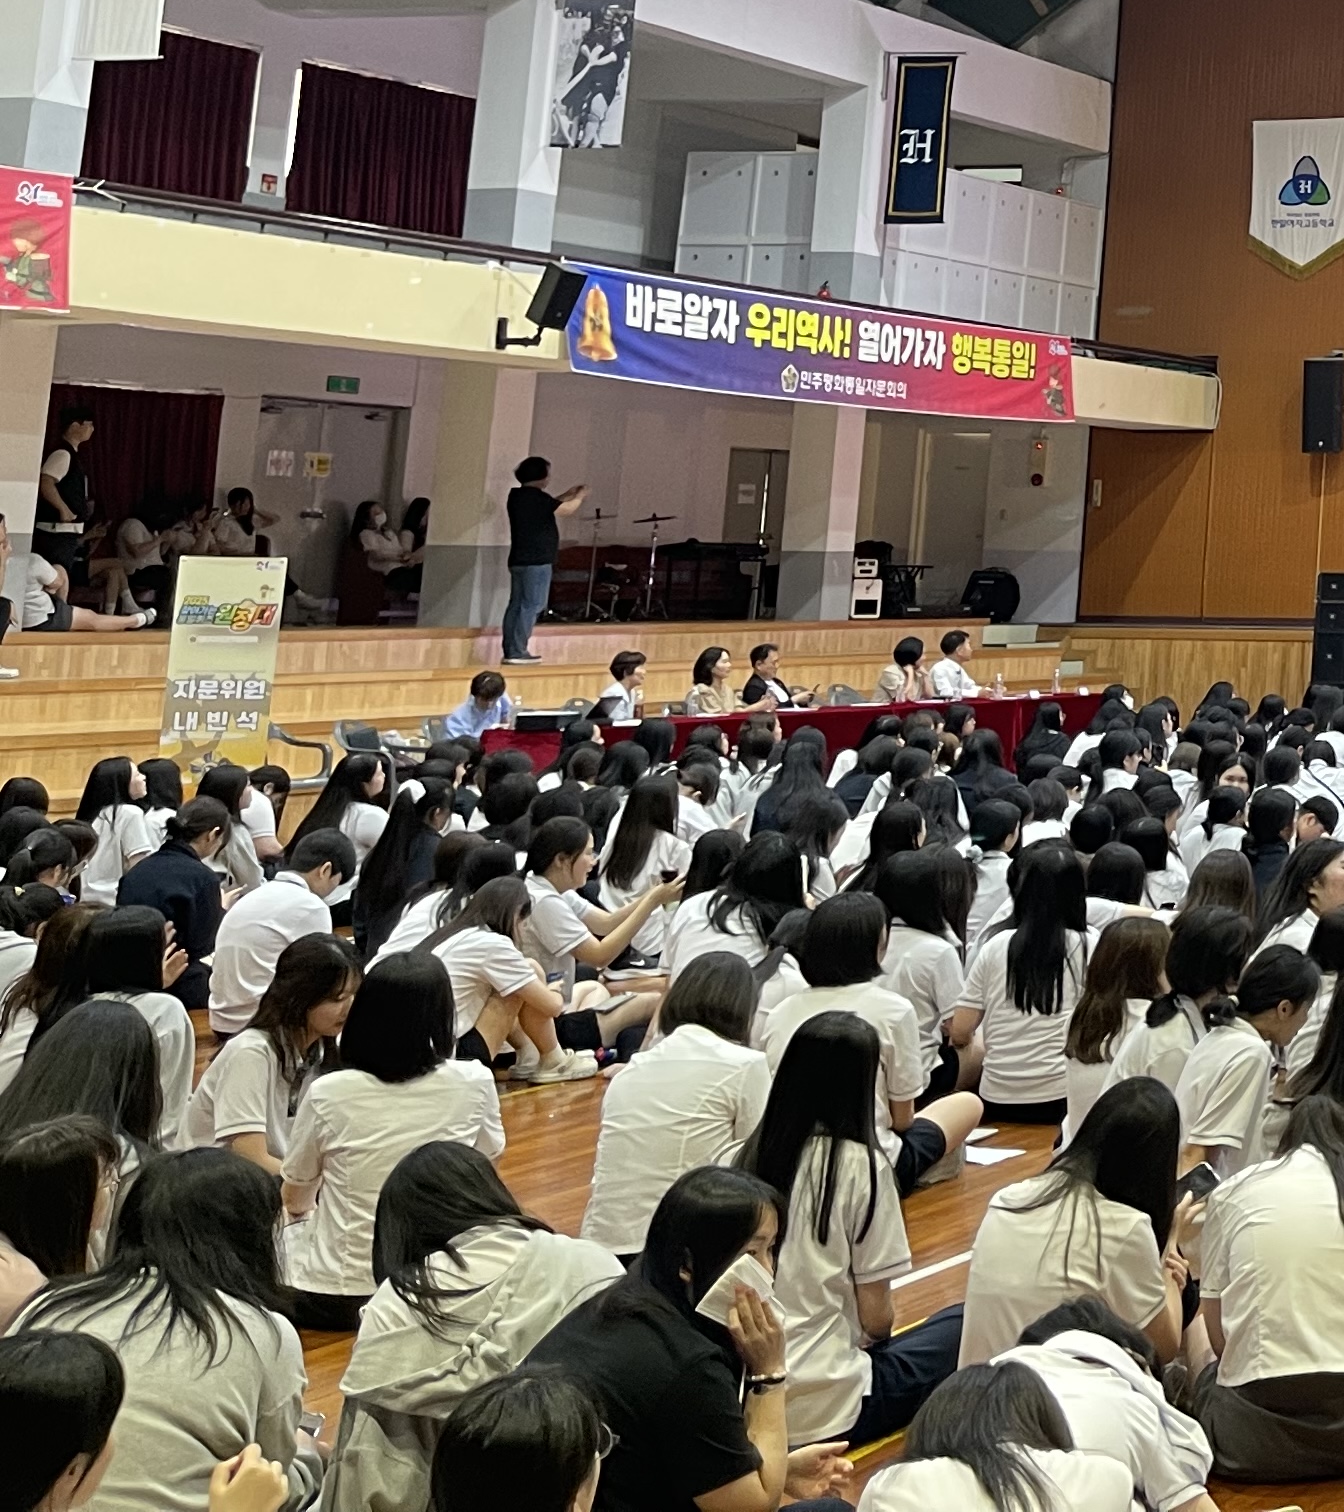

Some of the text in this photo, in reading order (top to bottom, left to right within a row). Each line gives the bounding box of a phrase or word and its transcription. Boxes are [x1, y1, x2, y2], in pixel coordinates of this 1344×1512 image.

[900, 129, 936, 164] H
[624, 282, 1037, 379] 바로알자 우리역사! 열어가자 행복통일!
[800, 370, 908, 399] 민주평화통일자문회의
[173, 679, 267, 700] 자문위원
